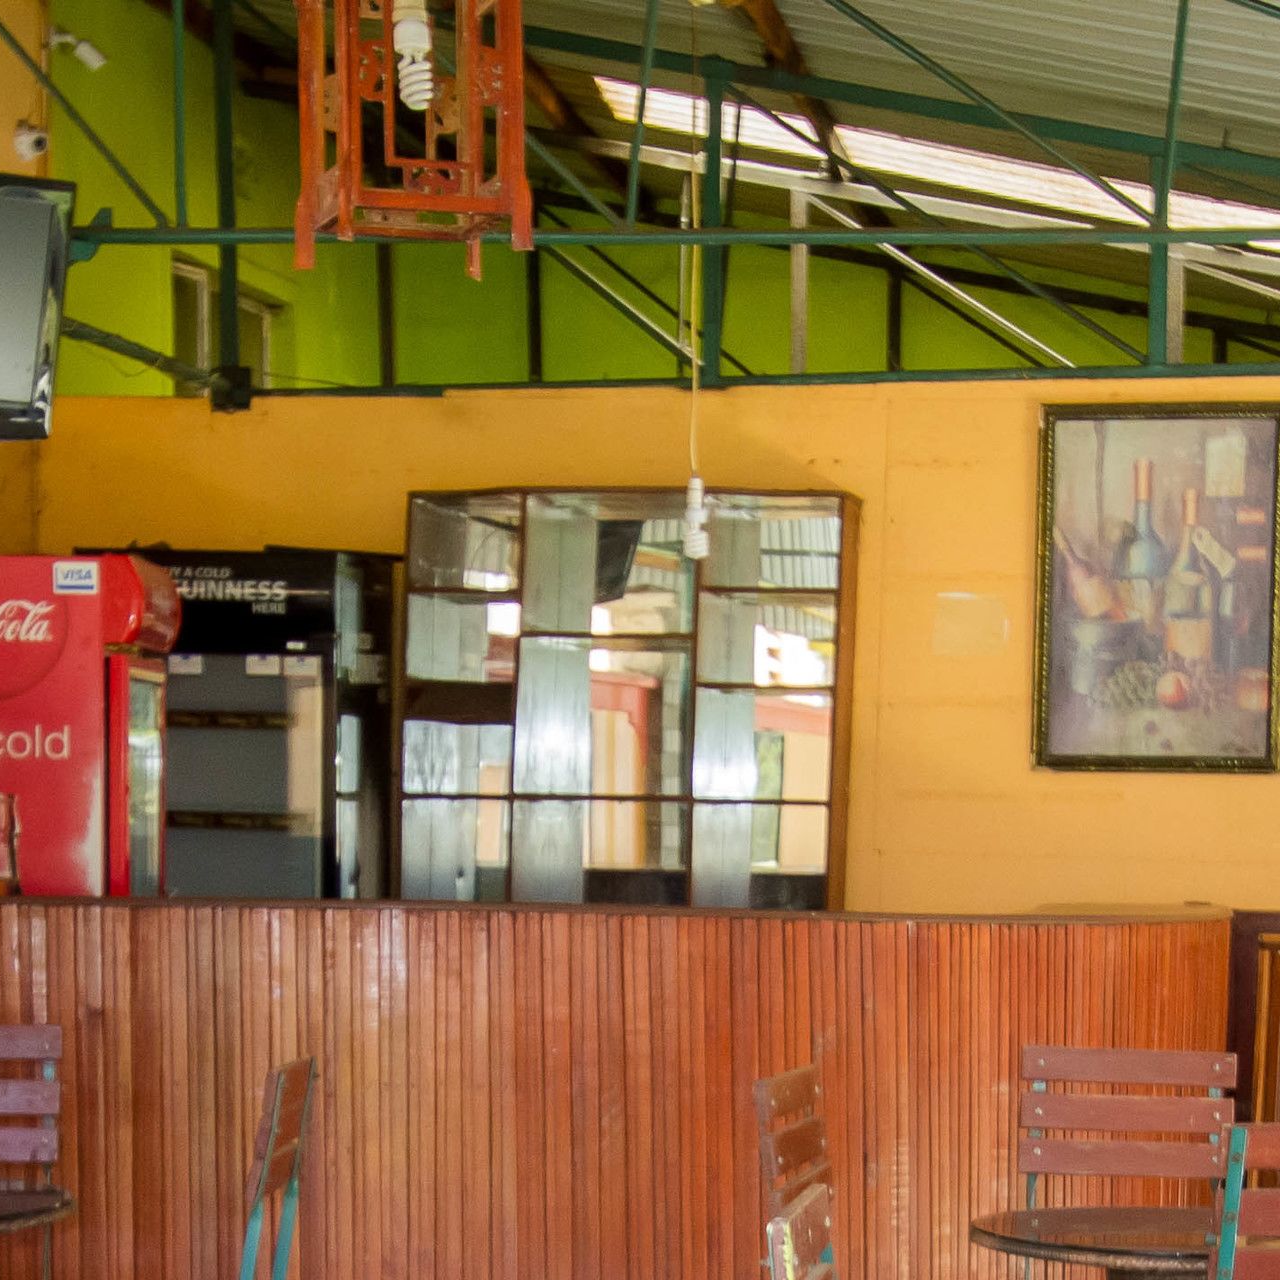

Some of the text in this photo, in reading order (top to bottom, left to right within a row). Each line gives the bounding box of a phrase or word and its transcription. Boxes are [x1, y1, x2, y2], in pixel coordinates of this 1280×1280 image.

[61, 568, 93, 581] VISA
[195, 567, 232, 579] COLD
[252, 602, 286, 615] HERE
